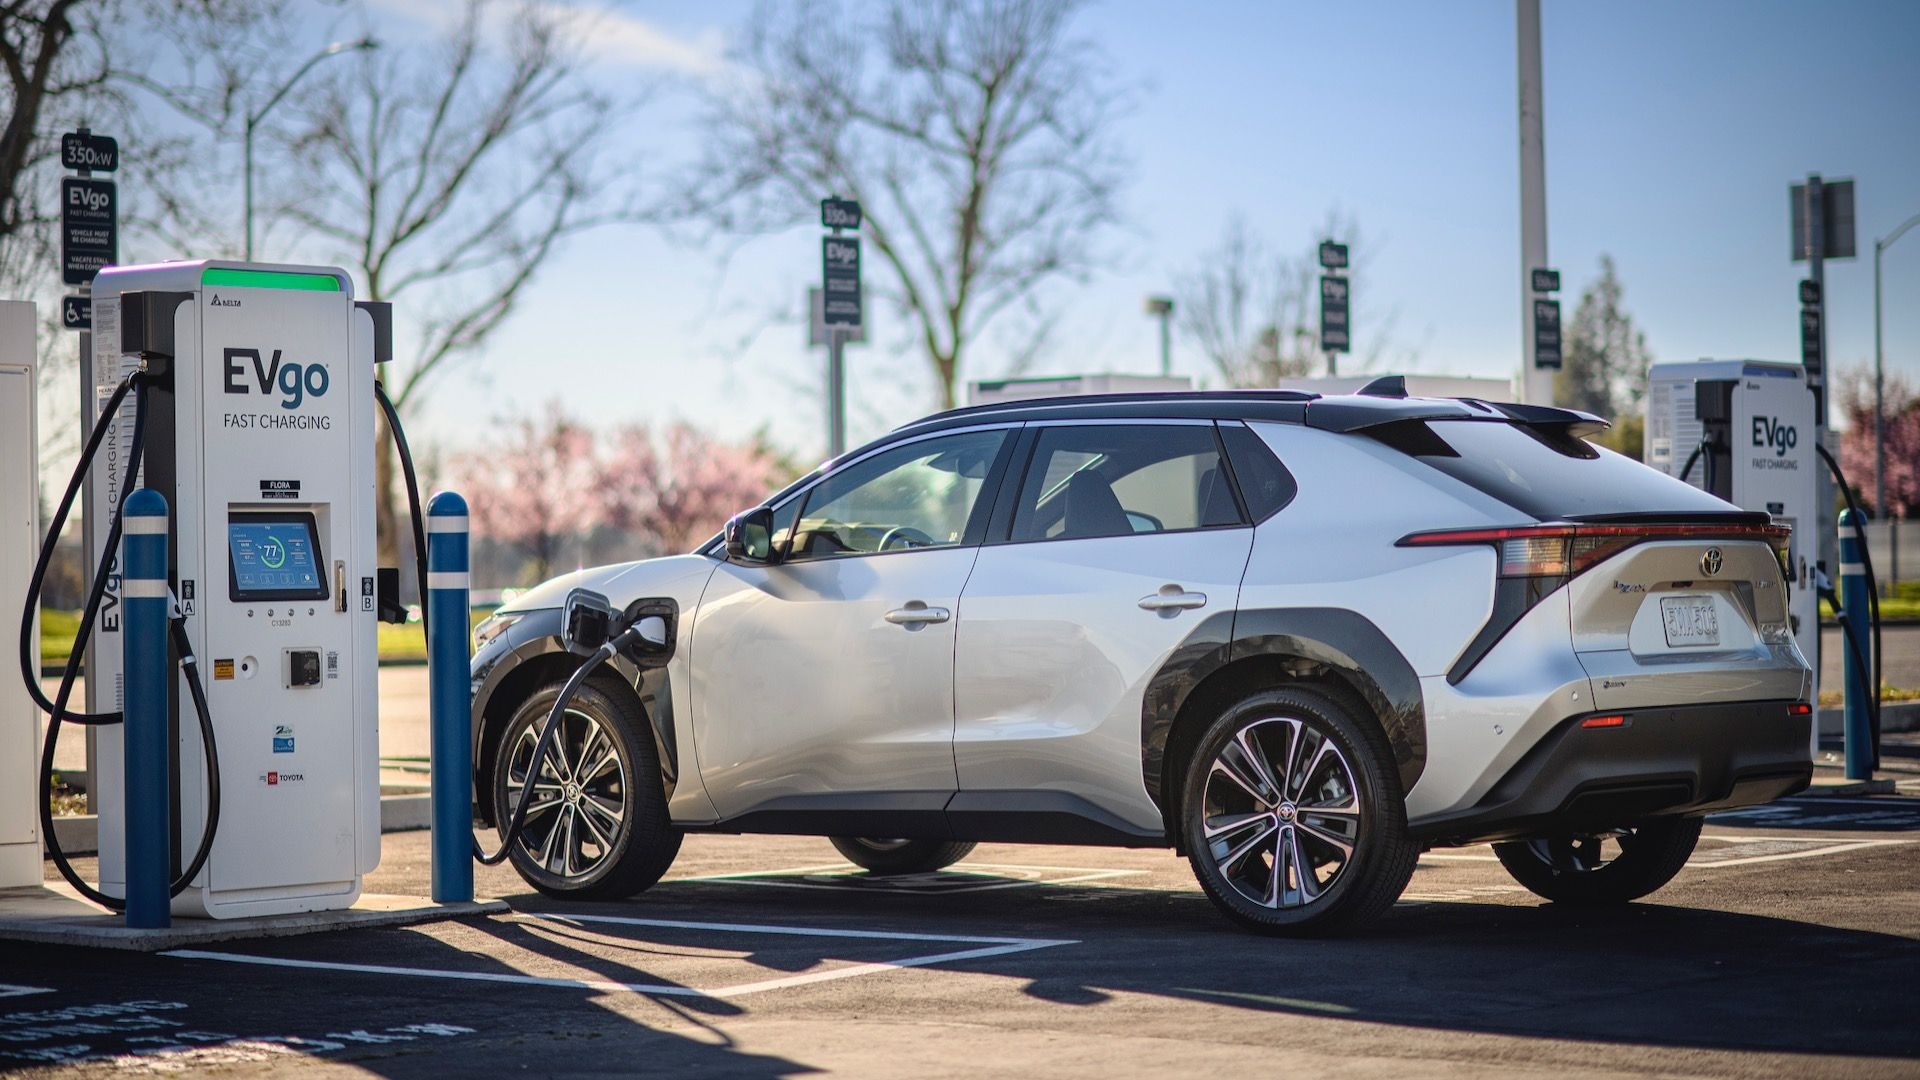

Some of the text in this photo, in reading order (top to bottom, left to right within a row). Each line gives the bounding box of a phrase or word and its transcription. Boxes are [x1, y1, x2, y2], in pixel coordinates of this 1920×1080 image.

[68, 146, 112, 166] 350kW
[69, 186, 109, 210] EVgo
[70, 229, 94, 237] VEHICLE
[223, 347, 329, 410] EVgo
[224, 413, 331, 430] FAST CHARGING
[1752, 415, 1797, 457] EVgo
[107, 423, 117, 505] CHARGING
[1752, 458, 1798, 471] FAST CHARGING
[270, 481, 290, 489] FLORA
[263, 544, 277, 557] 77
[184, 601, 193, 613] A
[364, 598, 372, 609] B
